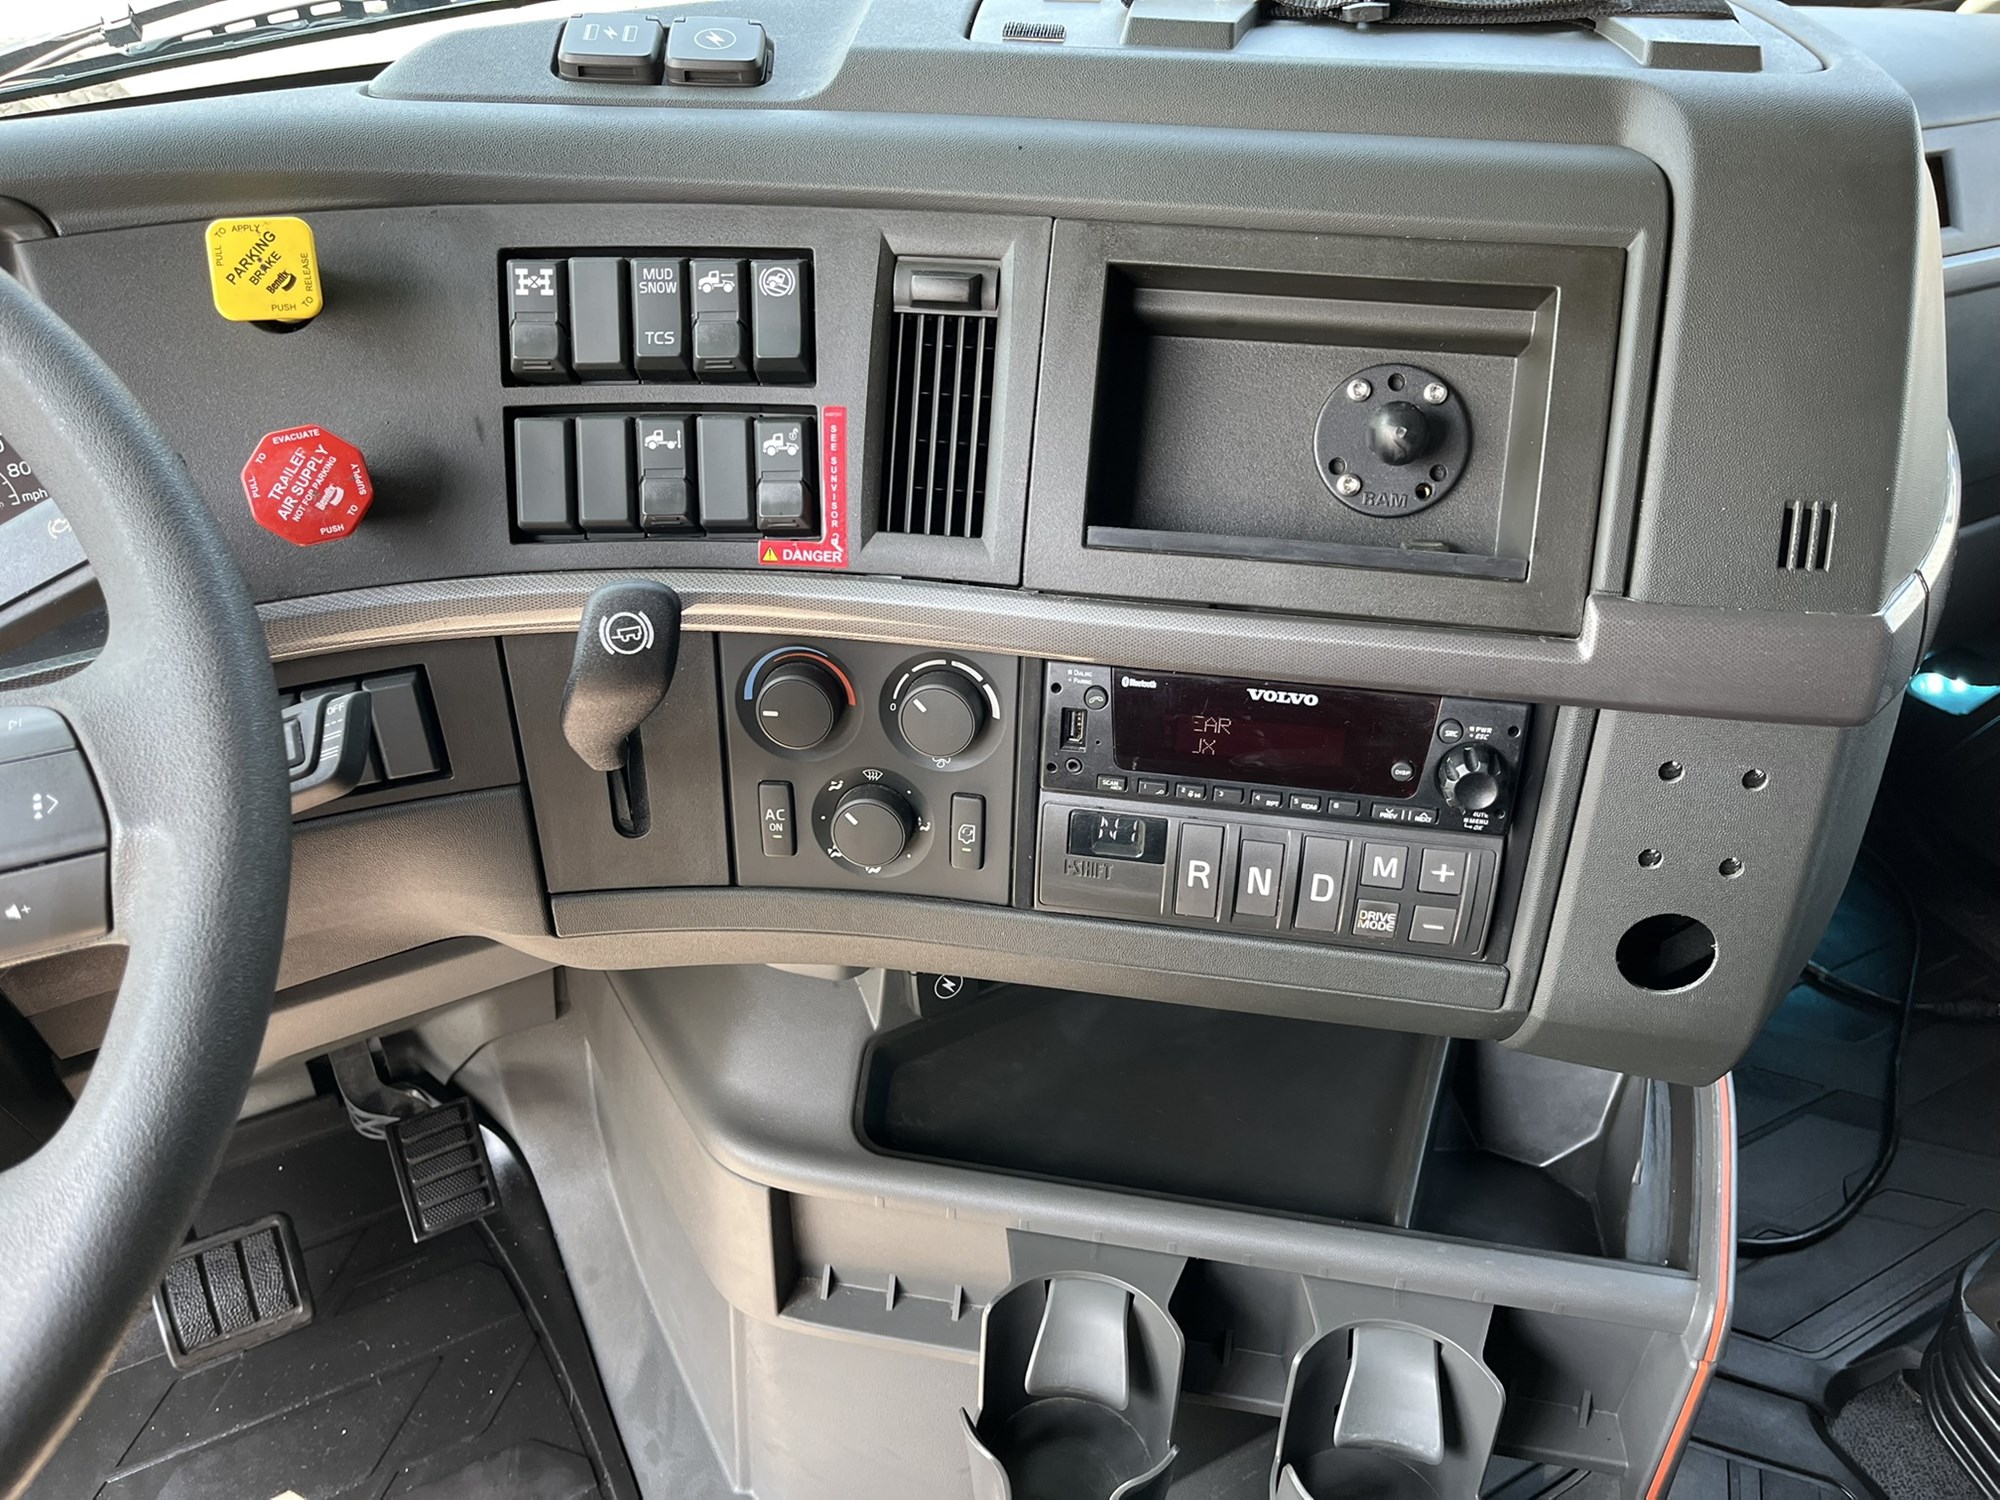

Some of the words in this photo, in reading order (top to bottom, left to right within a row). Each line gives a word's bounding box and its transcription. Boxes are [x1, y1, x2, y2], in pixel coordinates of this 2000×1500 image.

[215, 227, 227, 238] TO
[231, 224, 260, 234] APPLY
[215, 245, 223, 266] PULL
[226, 230, 276, 285] PARKING
[249, 251, 282, 286] BRAKE
[300, 252, 313, 292] RELEASE
[643, 268, 673, 281] MUD
[266, 270, 290, 295] Bendix
[639, 281, 677, 294] SNOW
[271, 303, 297, 312] PUSH
[301, 296, 314, 308] TO
[644, 331, 675, 345] TCS
[830, 424, 838, 451] SEE
[6, 461, 32, 478] 80
[248, 475, 261, 499] PULL
[255, 452, 267, 465] TO
[272, 428, 320, 445] EVACUATE
[277, 495, 299, 521] AIR
[291, 444, 329, 496] SUPPLY
[351, 463, 367, 496] SUPPLY
[22, 488, 49, 502] mph
[292, 504, 307, 522] NOT
[303, 489, 316, 507] FOR
[313, 456, 337, 490] PARKING
[830, 456, 839, 528] SUNVISOR
[1361, 491, 1409, 508] RAM
[346, 504, 358, 516] TO
[320, 524, 345, 535] PUSH
[782, 549, 842, 563] DANGER
[1246, 688, 1319, 706] VOLVO
[326, 702, 346, 715] OFF
[1445, 729, 1459, 738] SRC
[1475, 726, 1493, 734] PWR
[765, 809, 786, 821] AC
[769, 822, 783, 832] ON
[1063, 858, 1114, 880] I-SHIFT
[1187, 860, 1211, 889] R
[1372, 856, 1398, 878] M
[1246, 867, 1272, 896] N
[1310, 873, 1335, 902] D
[1359, 909, 1397, 922] DRIVE
[1357, 919, 1396, 932] MODE
